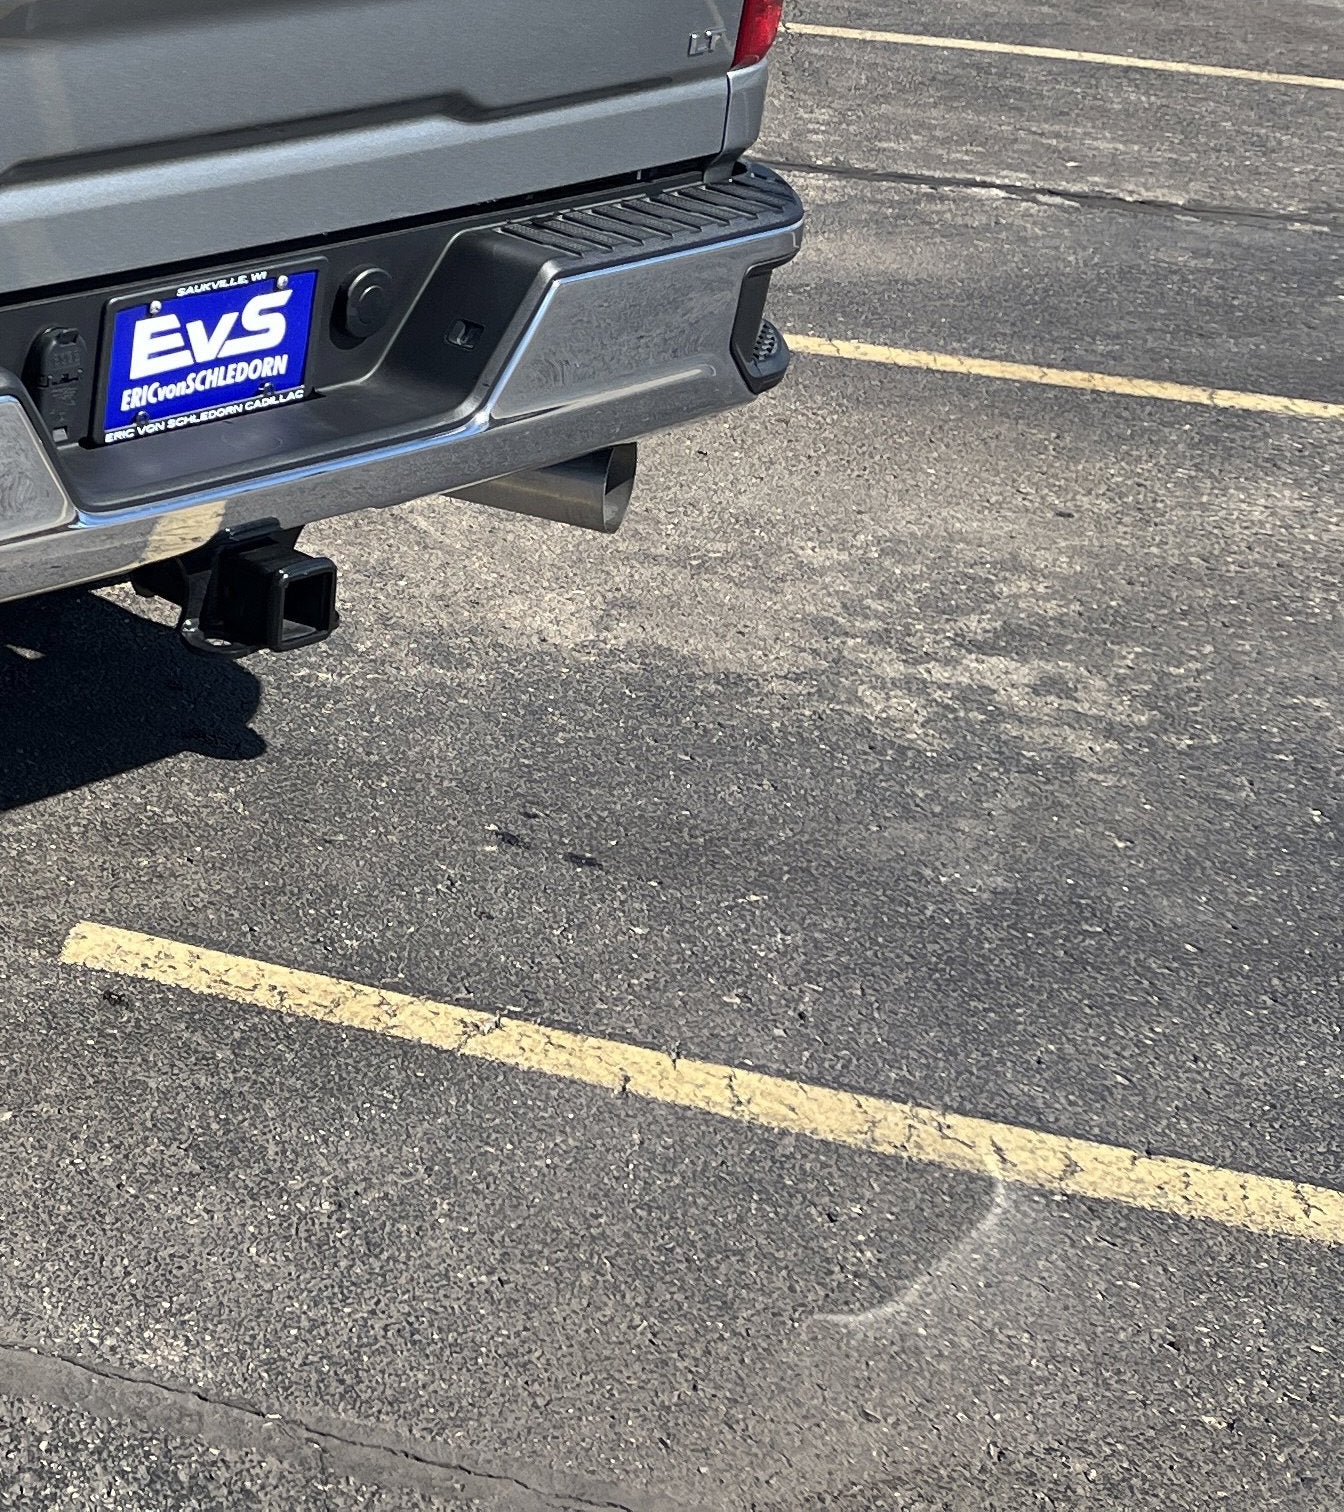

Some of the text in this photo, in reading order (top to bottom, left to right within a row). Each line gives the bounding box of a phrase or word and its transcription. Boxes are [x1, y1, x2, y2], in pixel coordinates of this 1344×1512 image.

[688, 28, 726, 57] LT
[250, 271, 268, 282] WI
[104, 389, 304, 443] ERIC VON SCHLEDORN CADILLAC
